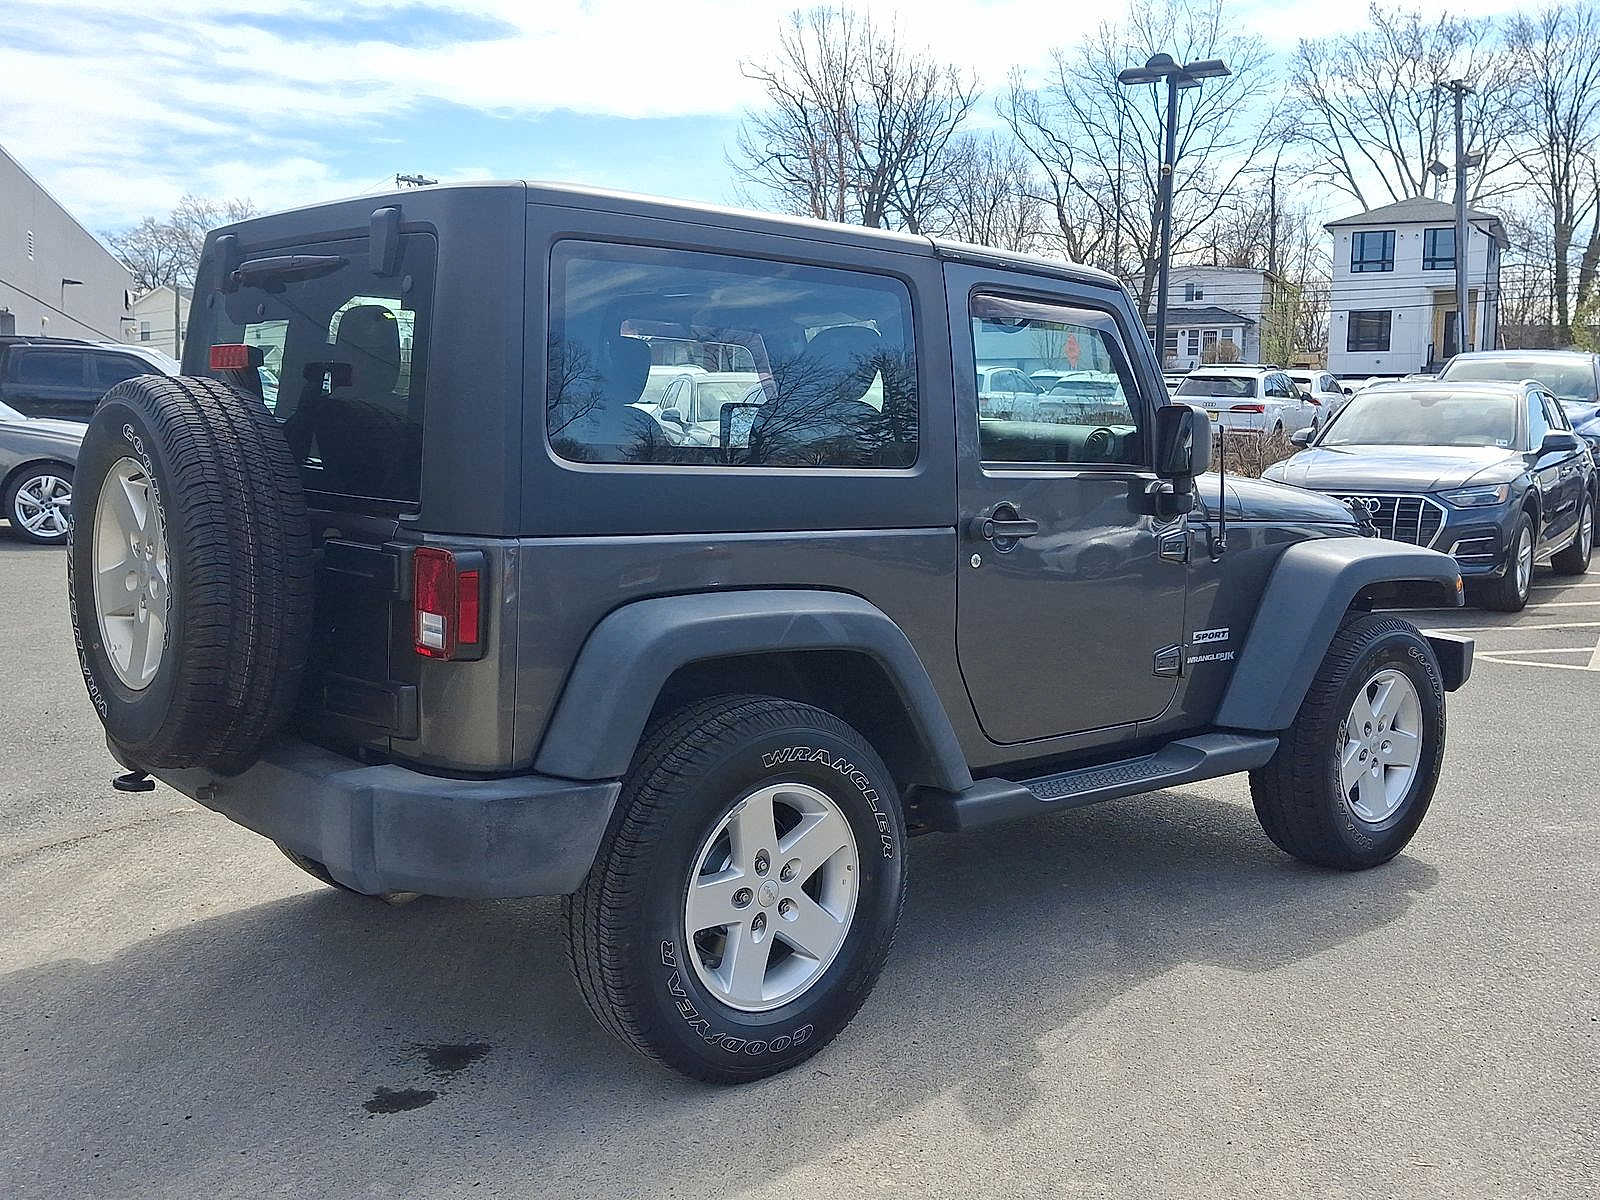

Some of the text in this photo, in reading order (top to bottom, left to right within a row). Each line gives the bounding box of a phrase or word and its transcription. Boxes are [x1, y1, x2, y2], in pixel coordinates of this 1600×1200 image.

[1187, 653, 1224, 663] WRANGLER
[1193, 630, 1229, 642] SPORT
[761, 746, 894, 859] WRANGLER
[660, 940, 814, 1055] GOODYEAR
